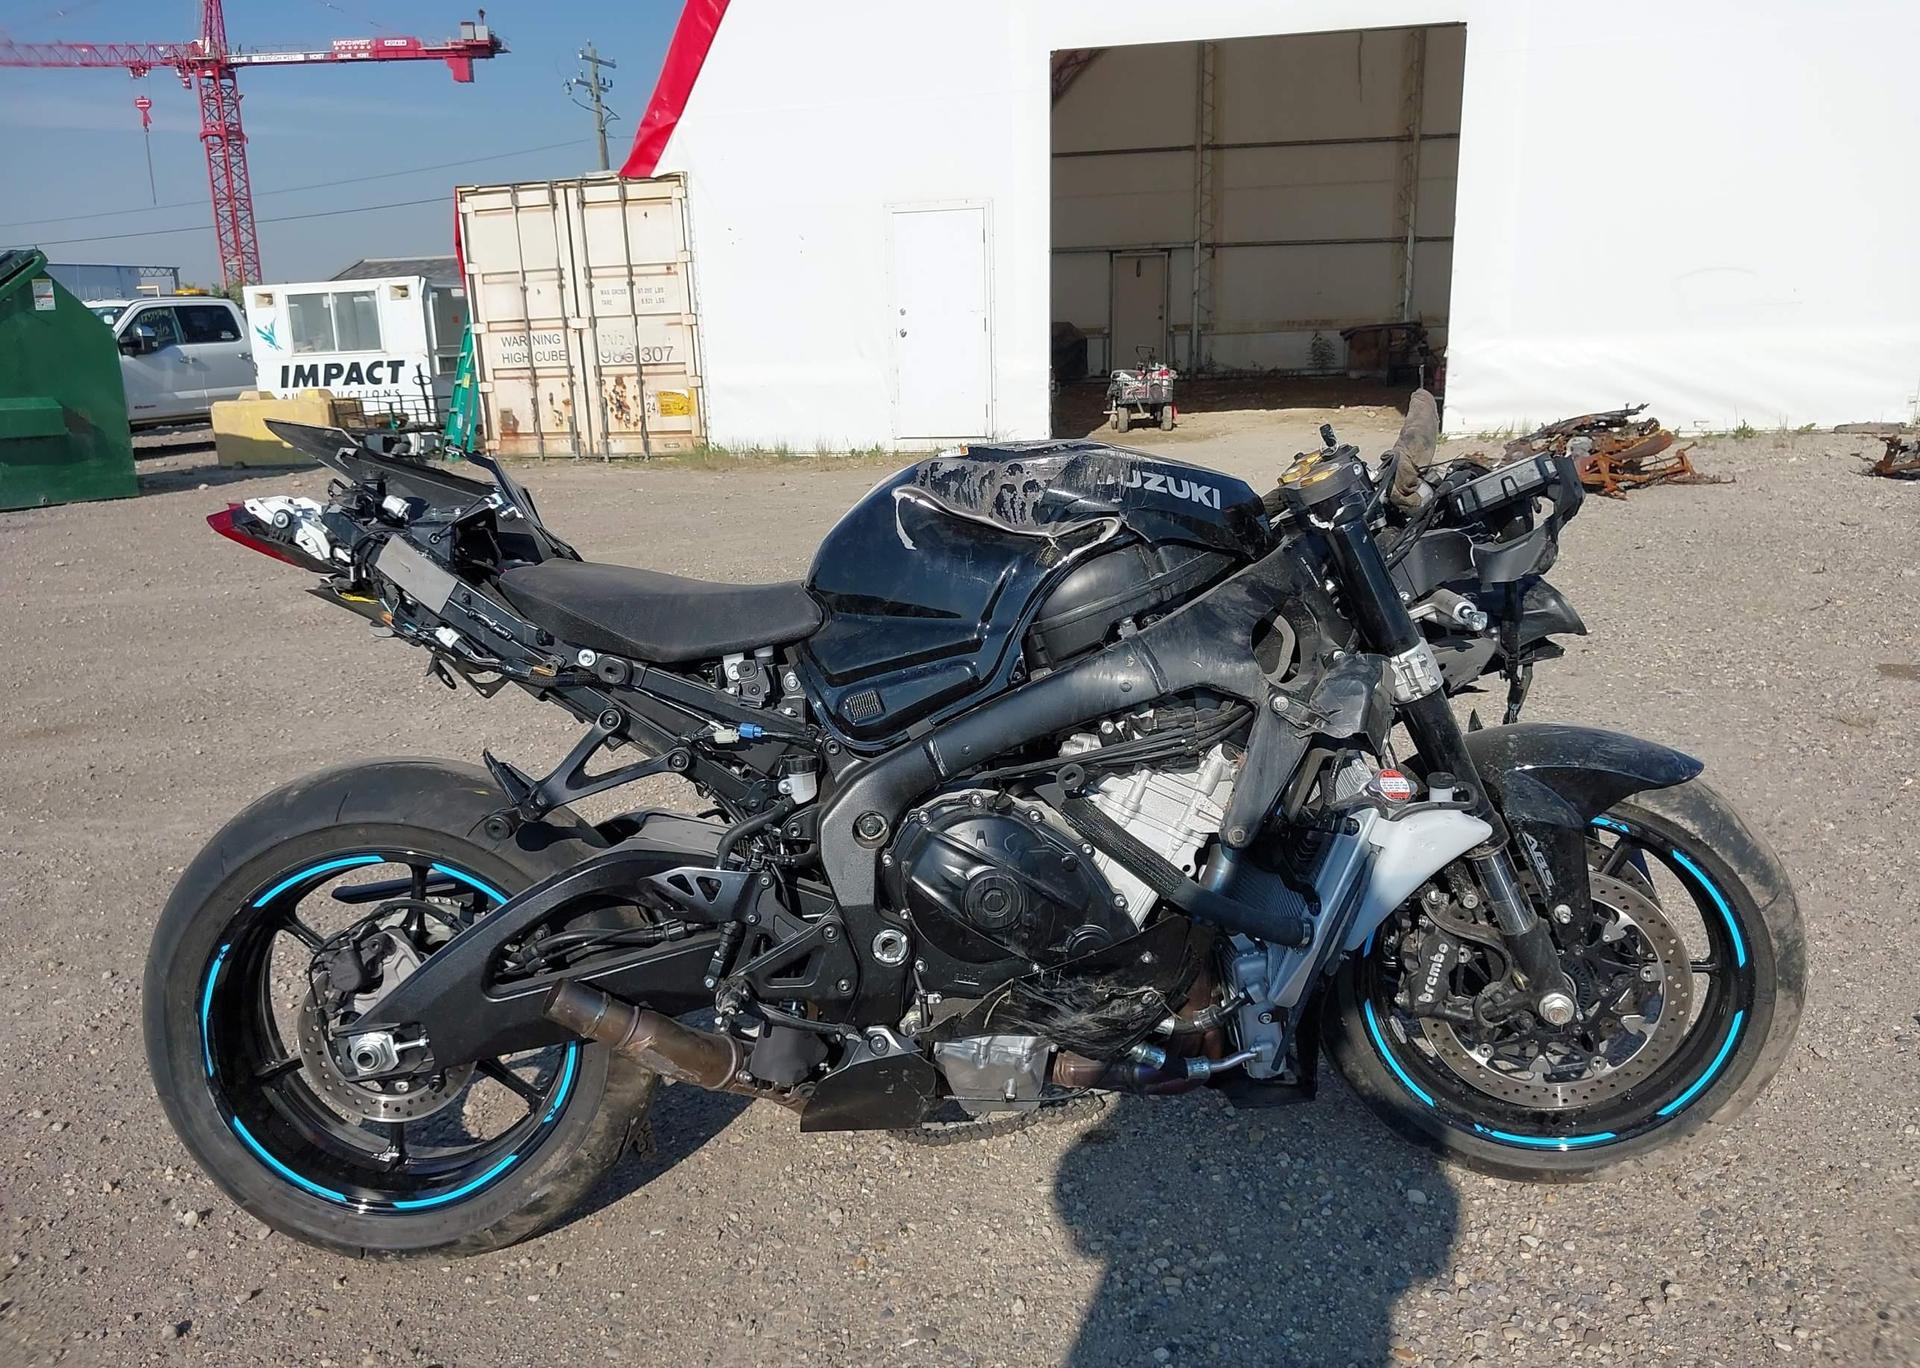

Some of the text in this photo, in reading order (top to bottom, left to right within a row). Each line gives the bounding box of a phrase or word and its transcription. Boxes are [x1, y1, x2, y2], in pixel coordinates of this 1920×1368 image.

[501, 333, 561, 347] WARNING
[502, 351, 567, 364] HIGH CUBE
[281, 360, 405, 388] IMPACT
[1106, 469, 1221, 510] UZUKI
[1417, 943, 1449, 1002] brembo
